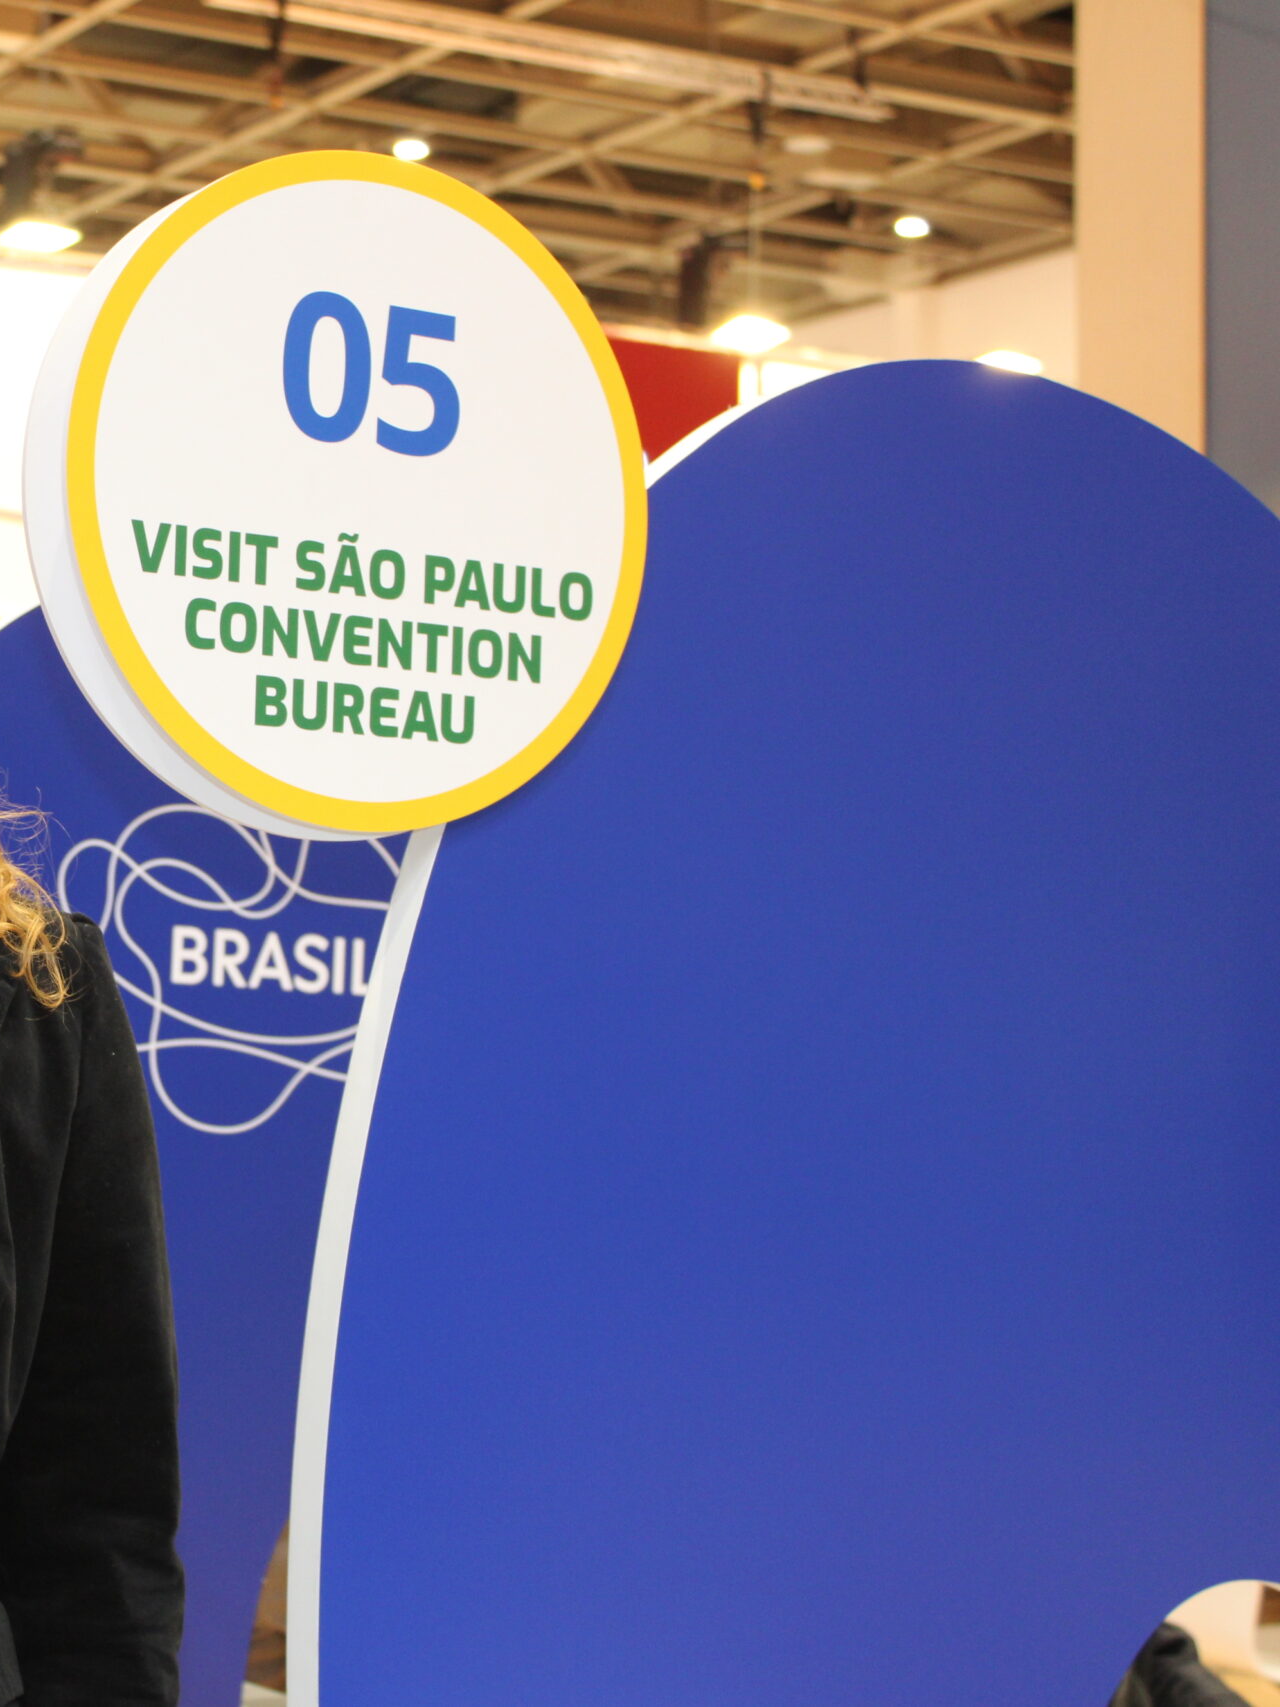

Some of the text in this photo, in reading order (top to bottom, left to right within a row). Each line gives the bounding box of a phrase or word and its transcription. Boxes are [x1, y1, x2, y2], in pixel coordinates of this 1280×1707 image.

[283, 290, 461, 457] 05
[131, 519, 594, 622] VISIT SÃO PAULO
[184, 598, 543, 684] CONVENTION
[254, 675, 476, 745] BUREAU
[170, 924, 370, 997] BRASIL
